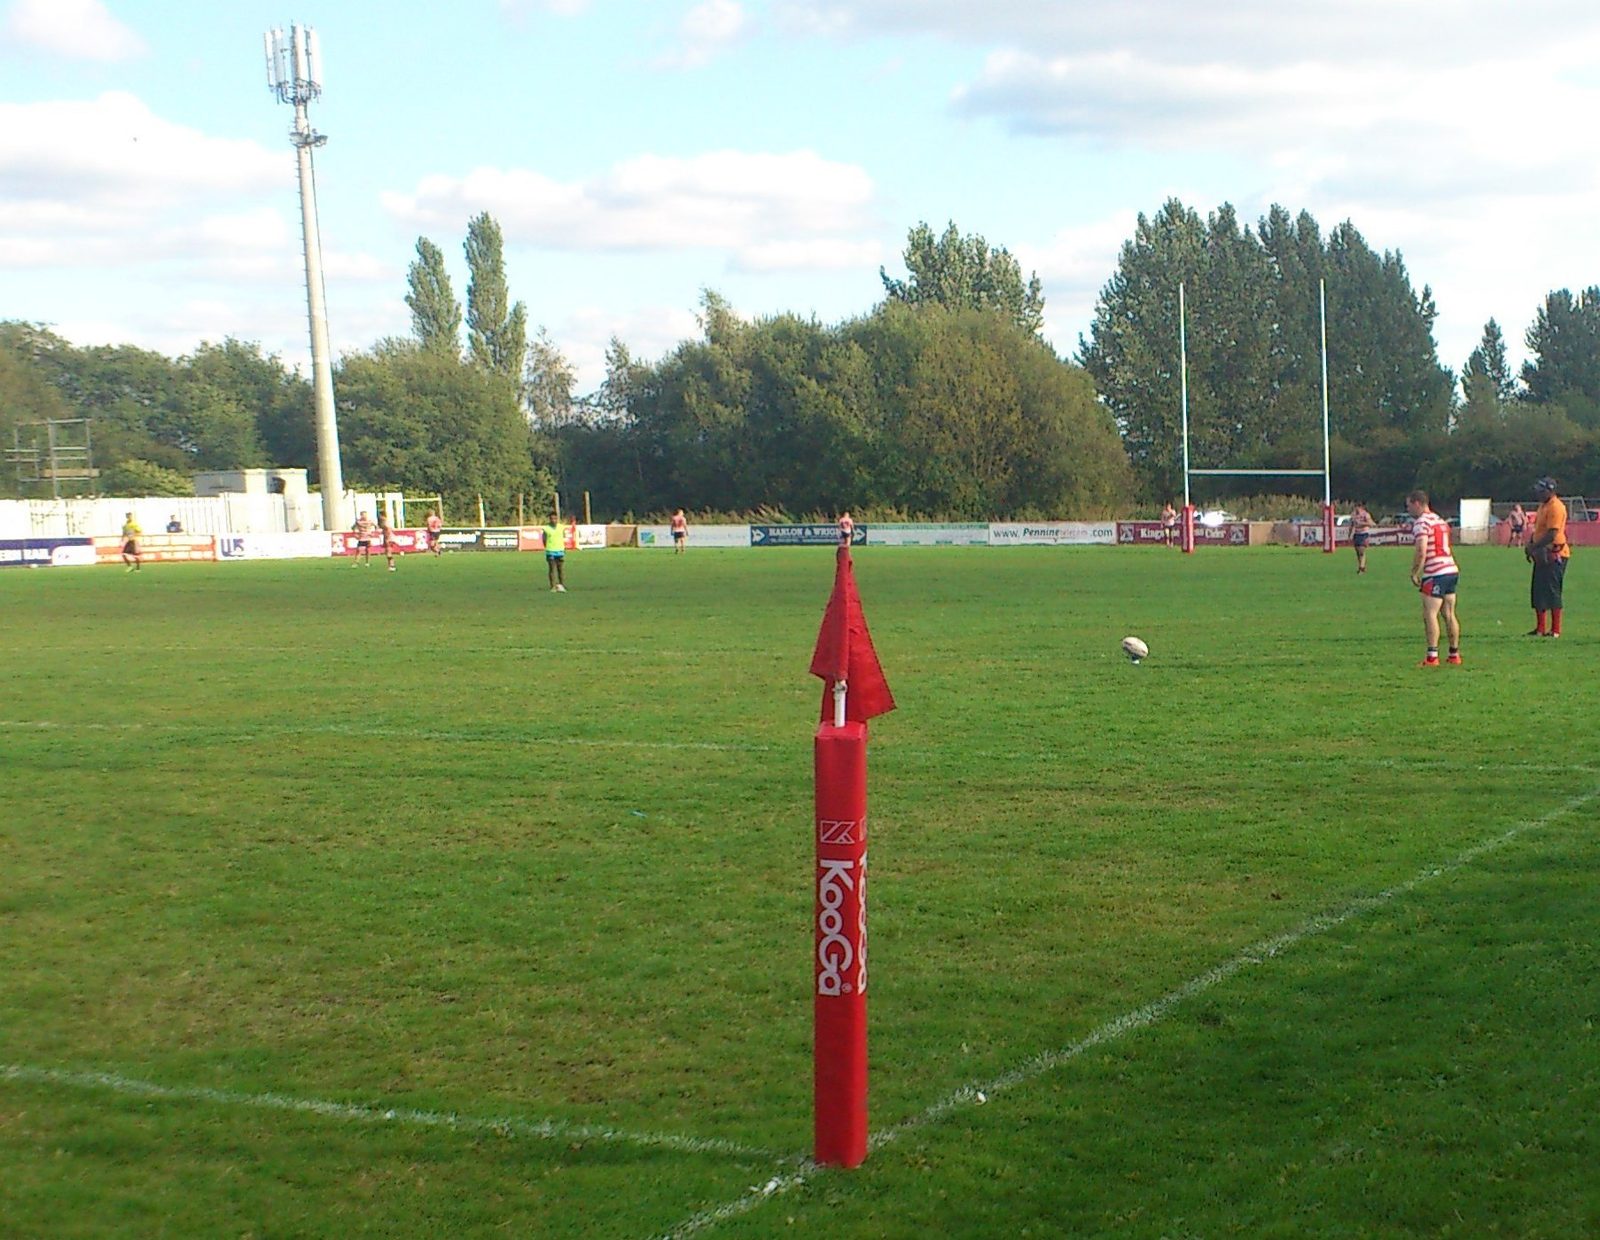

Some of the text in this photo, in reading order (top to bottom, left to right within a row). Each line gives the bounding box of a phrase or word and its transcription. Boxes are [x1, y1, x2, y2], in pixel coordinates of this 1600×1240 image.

[813, 527, 842, 537] WRIGH
[1141, 528, 1180, 541] Kingsne
[820, 859, 854, 996] KooGa
